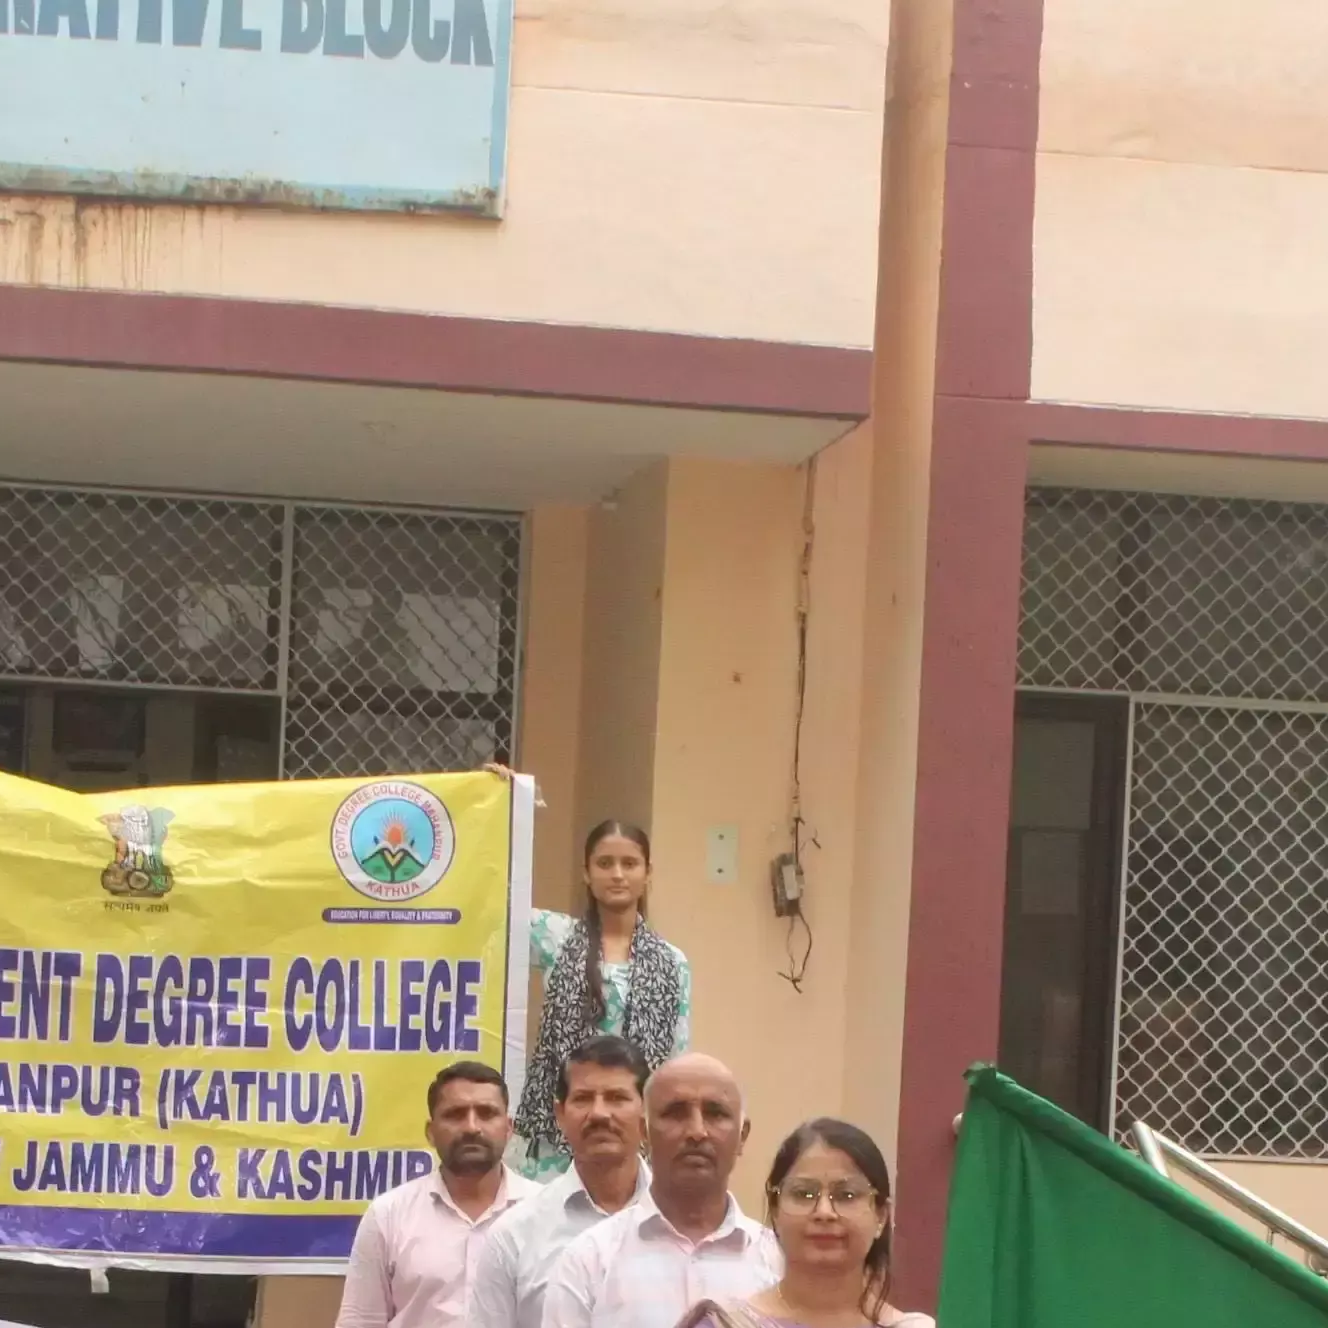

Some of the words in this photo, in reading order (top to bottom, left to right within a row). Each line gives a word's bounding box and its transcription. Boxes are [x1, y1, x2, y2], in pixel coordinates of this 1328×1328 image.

[338, 790, 370, 826] DEGREE
[365, 881, 420, 896] KATHUA
[93, 953, 271, 1049] DEGREE
[284, 956, 481, 1053] COLLEGE
[157, 1068, 364, 1136] (KATHUA)
[13, 1140, 174, 1197] JAMMU
[190, 1145, 221, 1199] &
